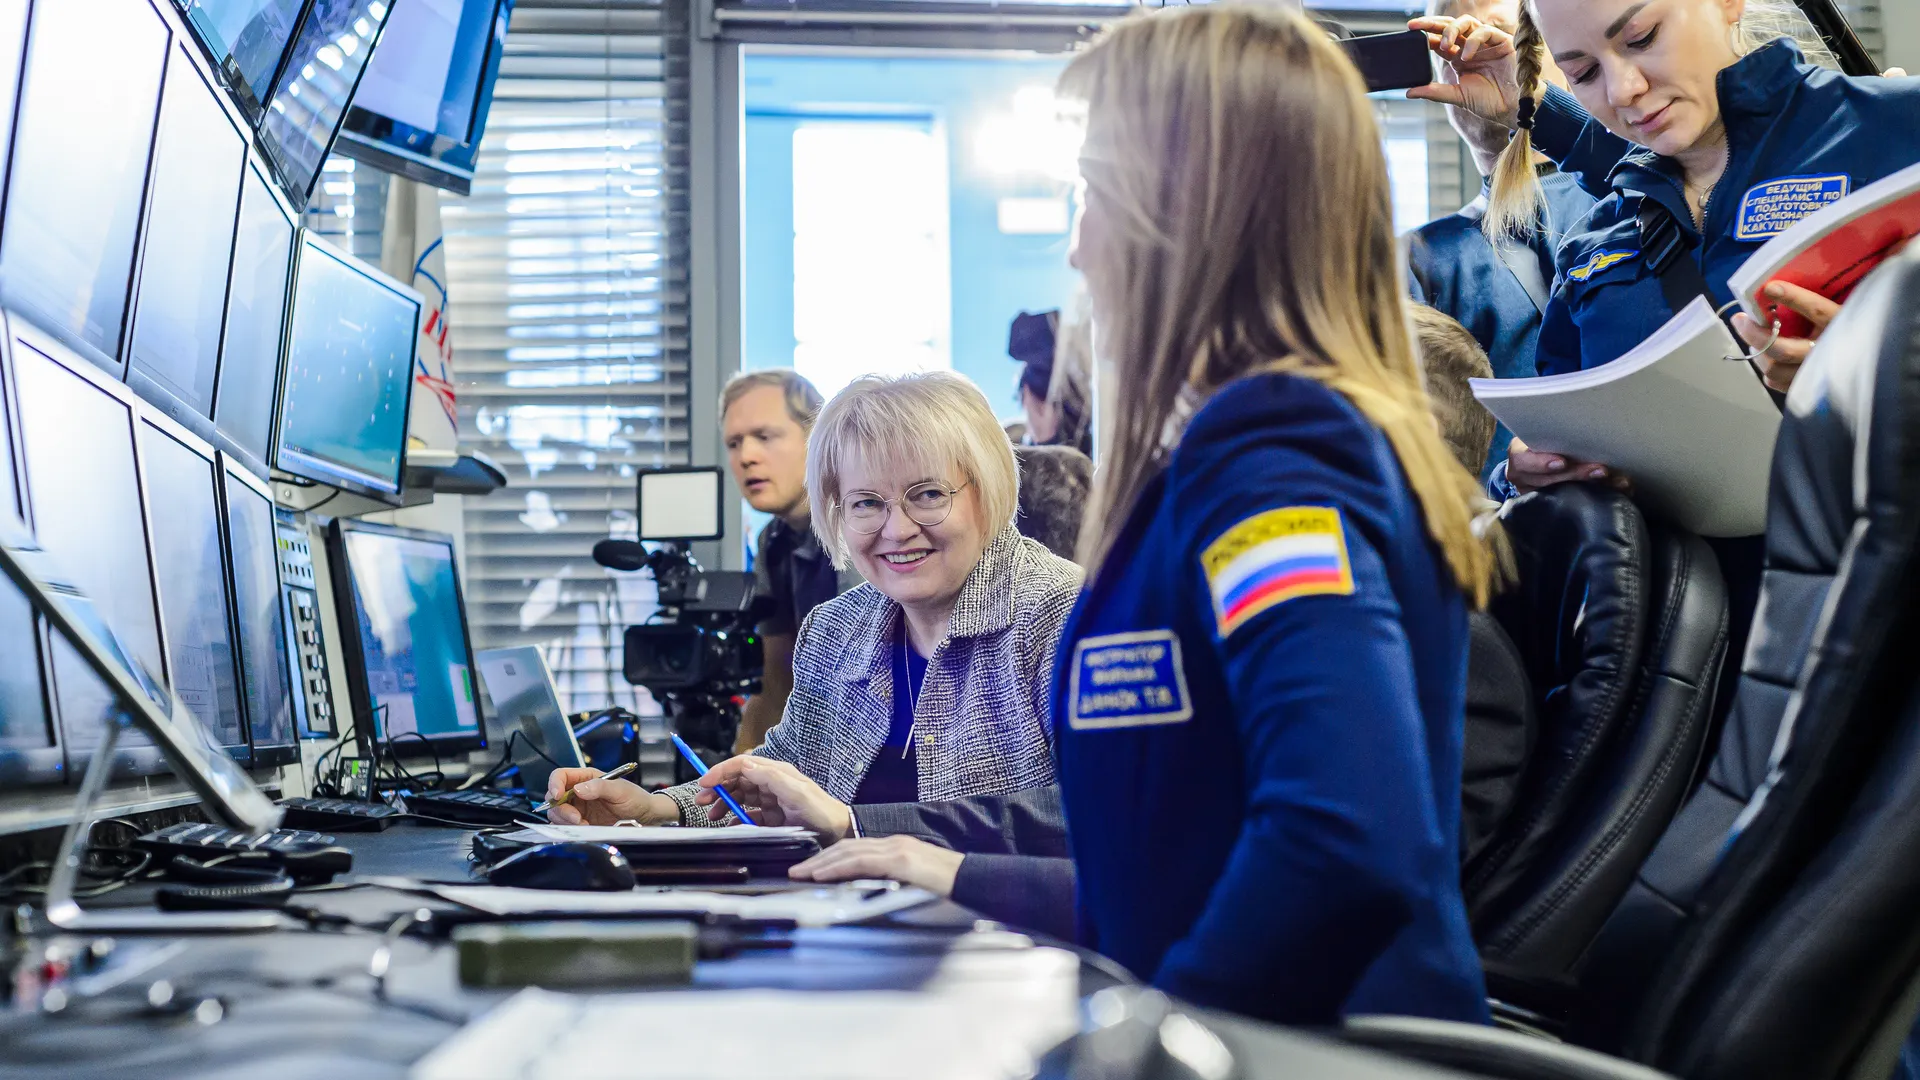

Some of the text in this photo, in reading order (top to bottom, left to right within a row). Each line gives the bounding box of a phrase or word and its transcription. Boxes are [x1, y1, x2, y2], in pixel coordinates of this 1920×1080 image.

[1766, 182, 1822, 194] ВЕДУЩИЙ
[1746, 191, 1840, 207] СПЕЦИАЛИСТ ПО
[1748, 211, 1813, 223] КОСМОНАВ
